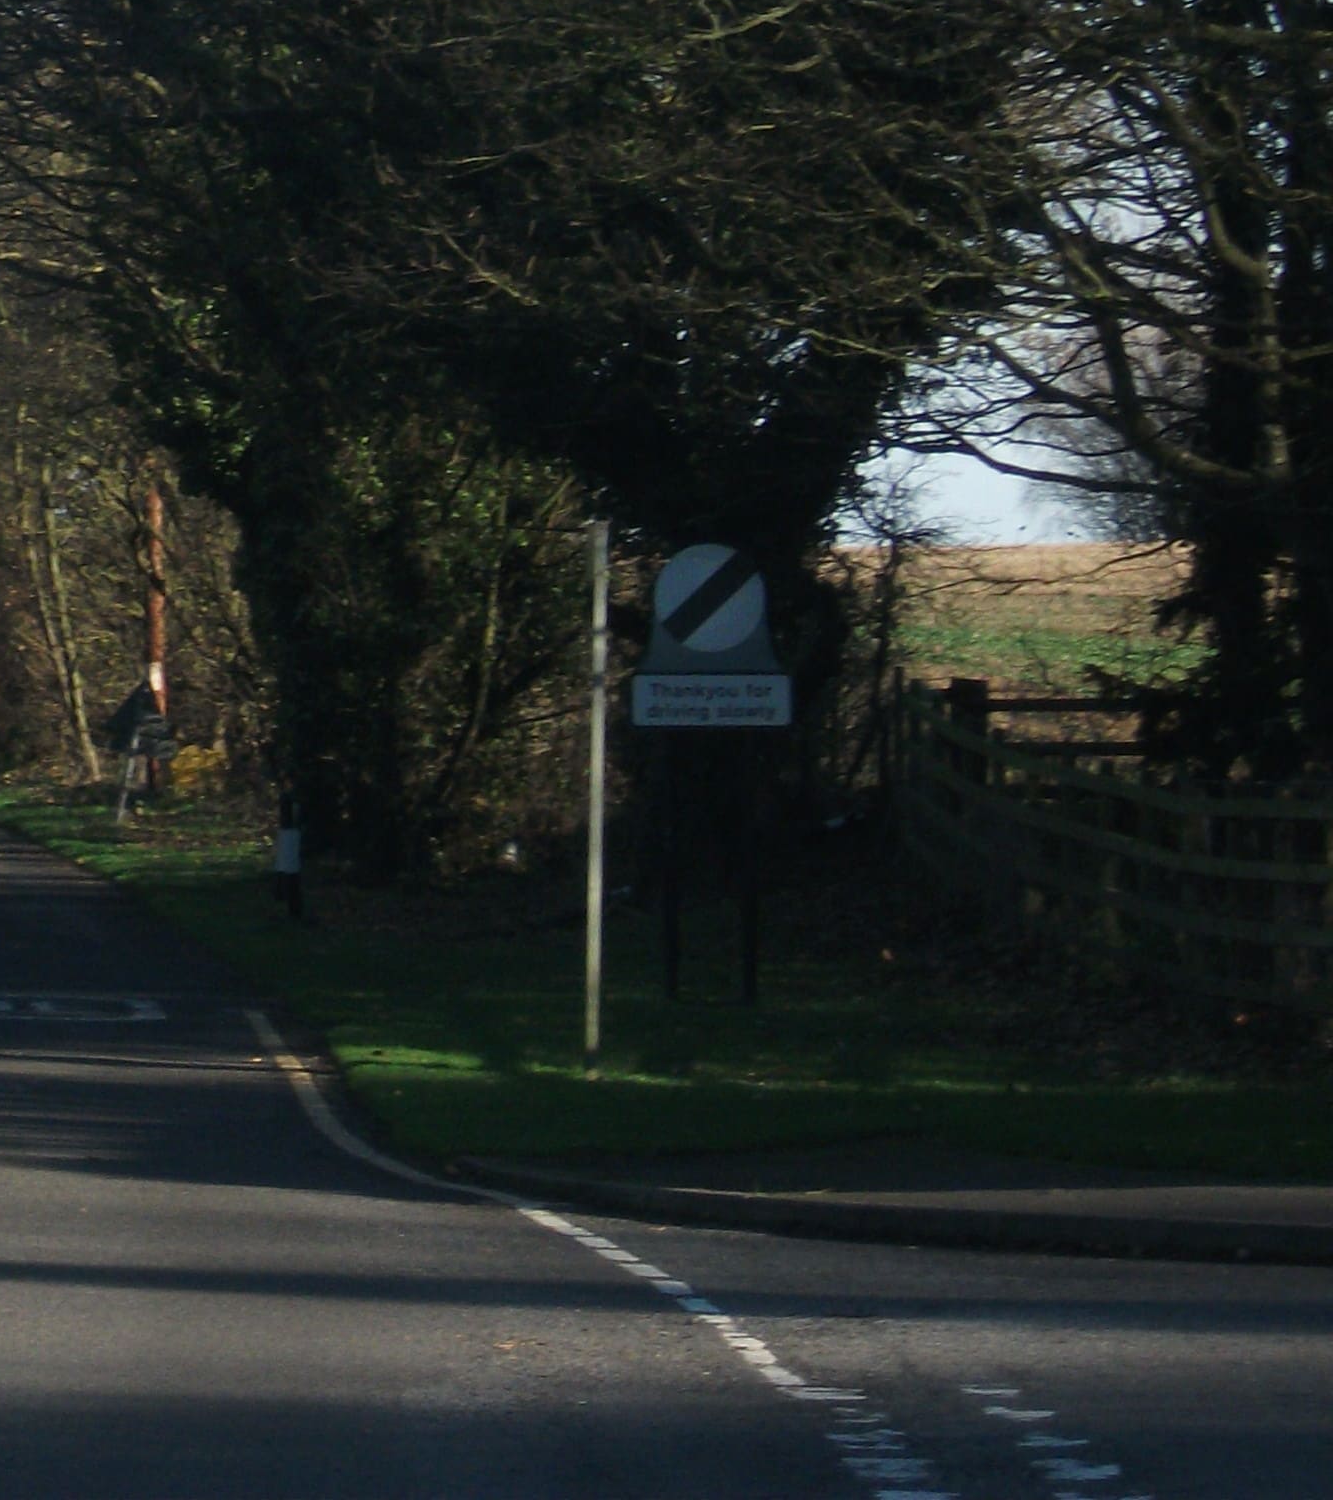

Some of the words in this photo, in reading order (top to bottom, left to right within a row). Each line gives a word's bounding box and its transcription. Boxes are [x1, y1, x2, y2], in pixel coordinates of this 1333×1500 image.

[649, 682, 740, 701] Thankyou
[746, 682, 773, 698] for
[647, 704, 710, 721] driving
[717, 704, 776, 722] slowly
